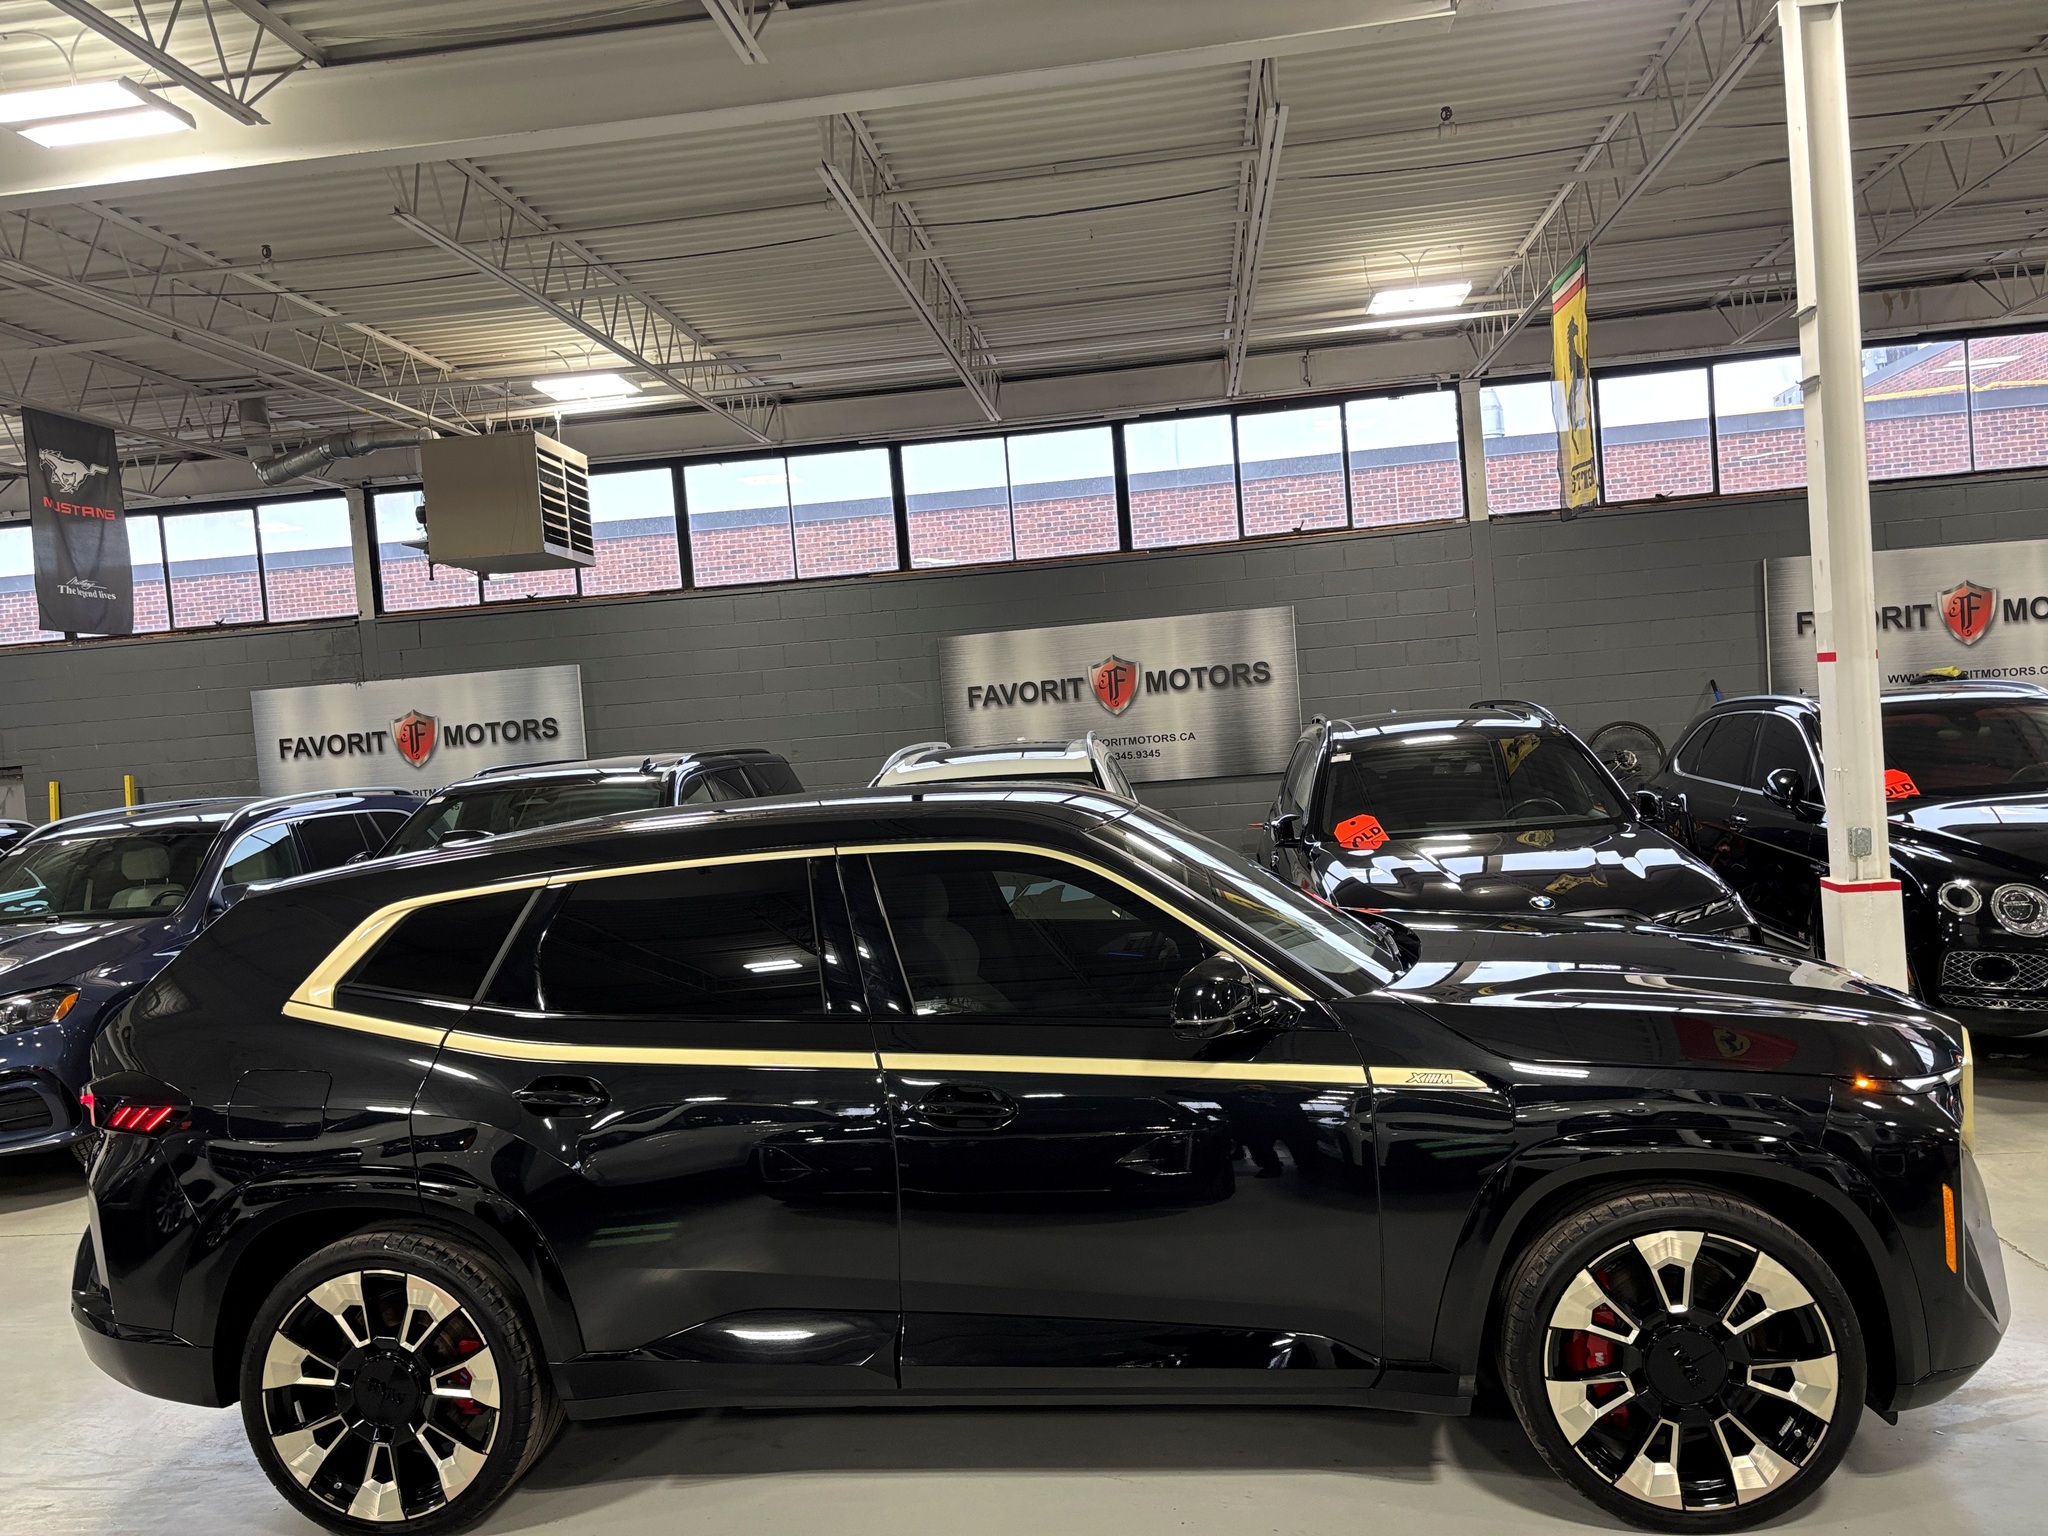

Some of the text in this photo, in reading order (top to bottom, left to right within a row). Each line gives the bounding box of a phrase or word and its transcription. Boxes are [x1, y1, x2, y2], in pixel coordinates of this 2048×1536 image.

[57, 585, 117, 600] The legend lives
[1796, 603, 1932, 635] FRIT
[967, 677, 1084, 708] FAVORIT
[1145, 661, 1271, 693] MOTORS
[278, 730, 388, 759] FAVORIT
[443, 717, 559, 747] MOTORS
[1098, 732, 1196, 748] ORITMOTORS.CA
[1114, 749, 1161, 761] 345.9345
[1885, 783, 1914, 797] OLD
[1352, 826, 1382, 846] OLD
